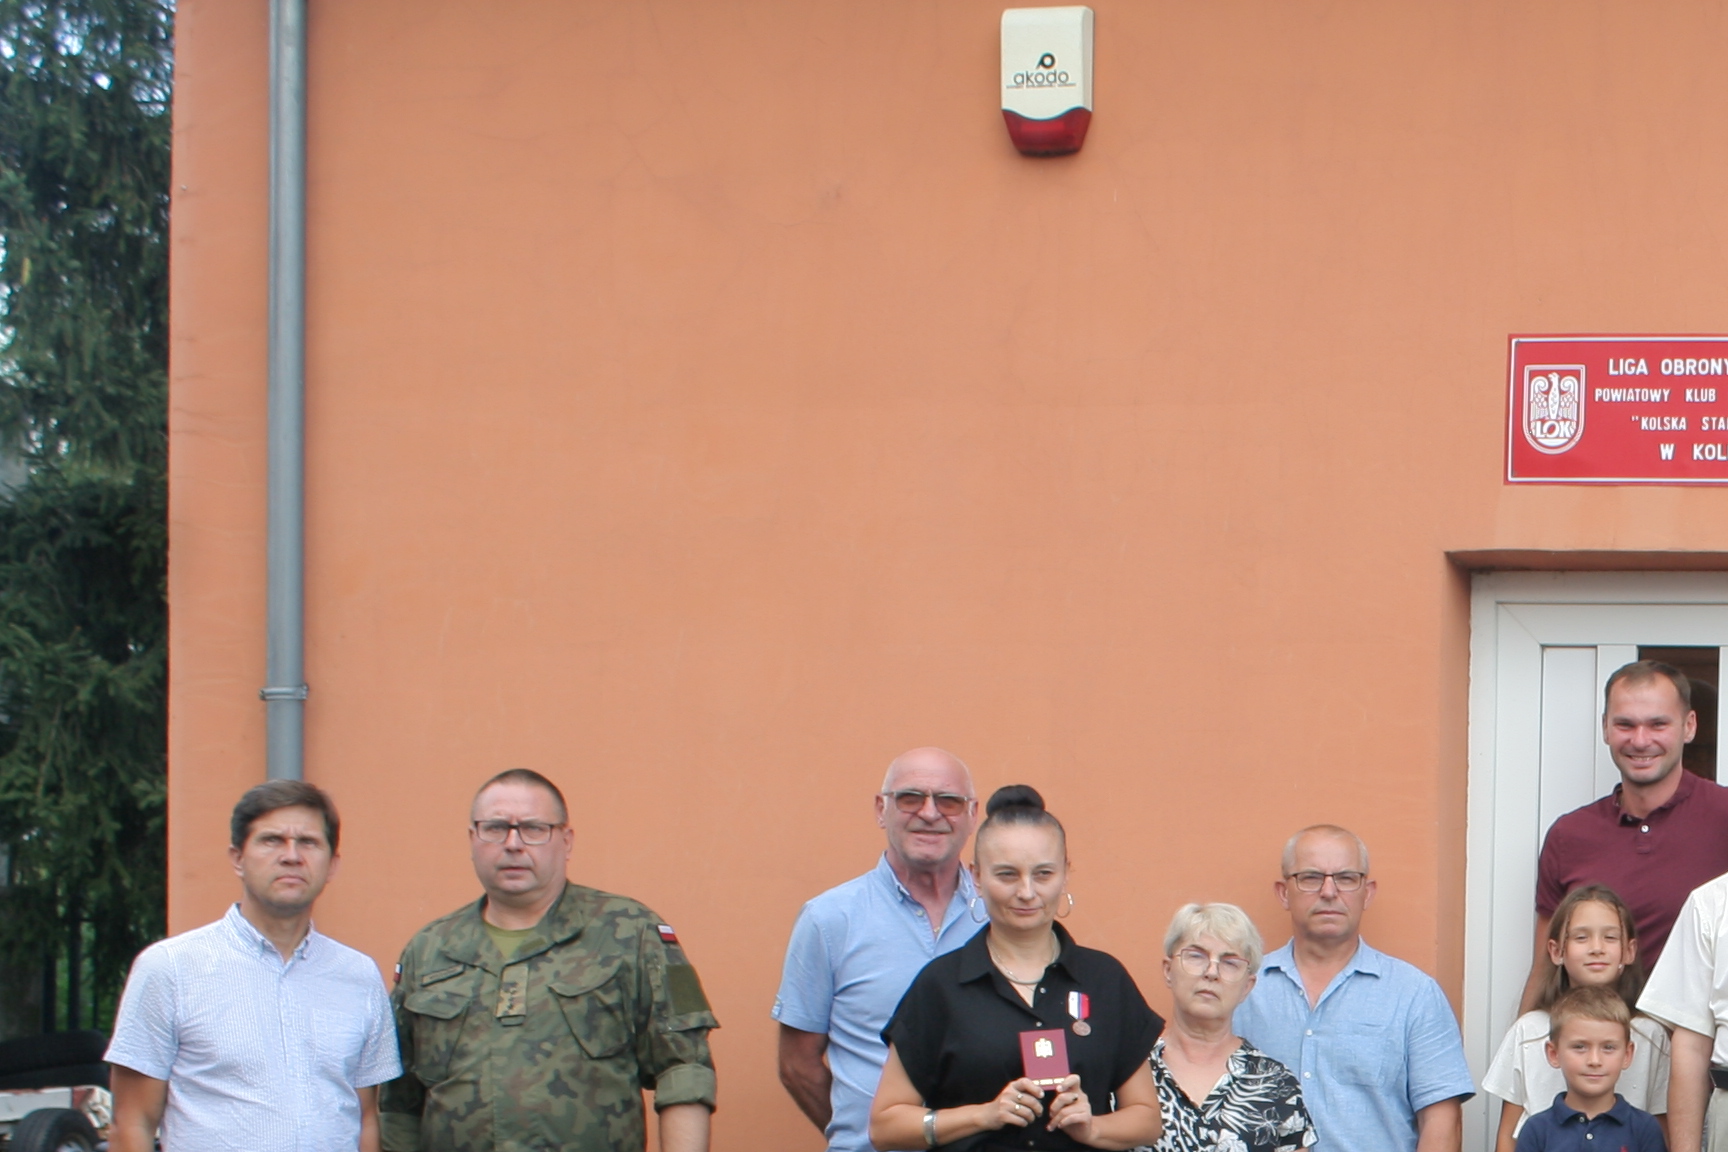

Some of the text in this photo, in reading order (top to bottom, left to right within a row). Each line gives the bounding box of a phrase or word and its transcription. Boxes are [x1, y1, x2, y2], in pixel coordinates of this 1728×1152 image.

[1013, 69, 1069, 86] akodo
[1608, 358, 1649, 376] LIGA
[1594, 387, 1670, 402] POWIATOWY
[1685, 388, 1716, 403] KLUB
[1535, 420, 1573, 438] LOK
[1660, 442, 1675, 461] W
